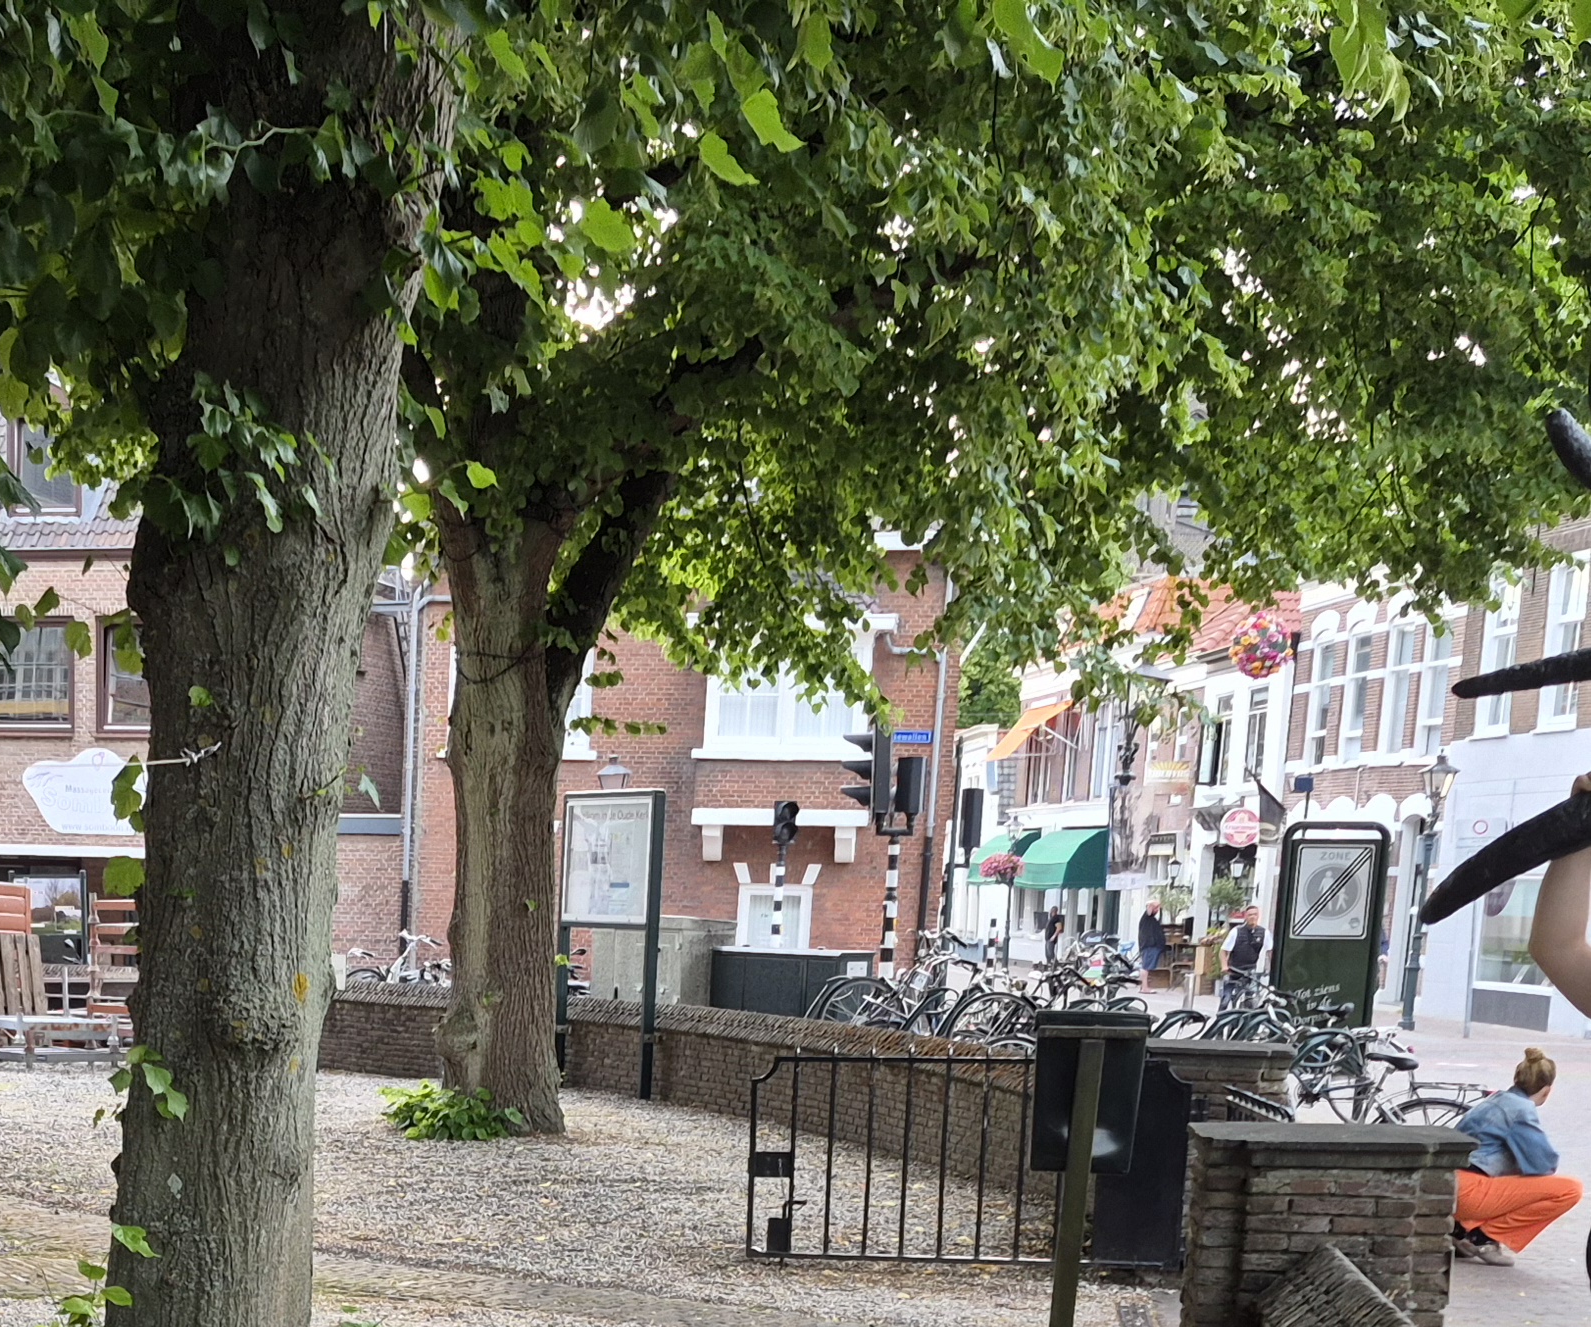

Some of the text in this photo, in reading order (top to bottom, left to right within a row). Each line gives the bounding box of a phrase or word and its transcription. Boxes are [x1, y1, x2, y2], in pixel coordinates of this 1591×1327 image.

[1320, 851, 1351, 860] ZONE
[1294, 983, 1340, 999] Tot ziens
